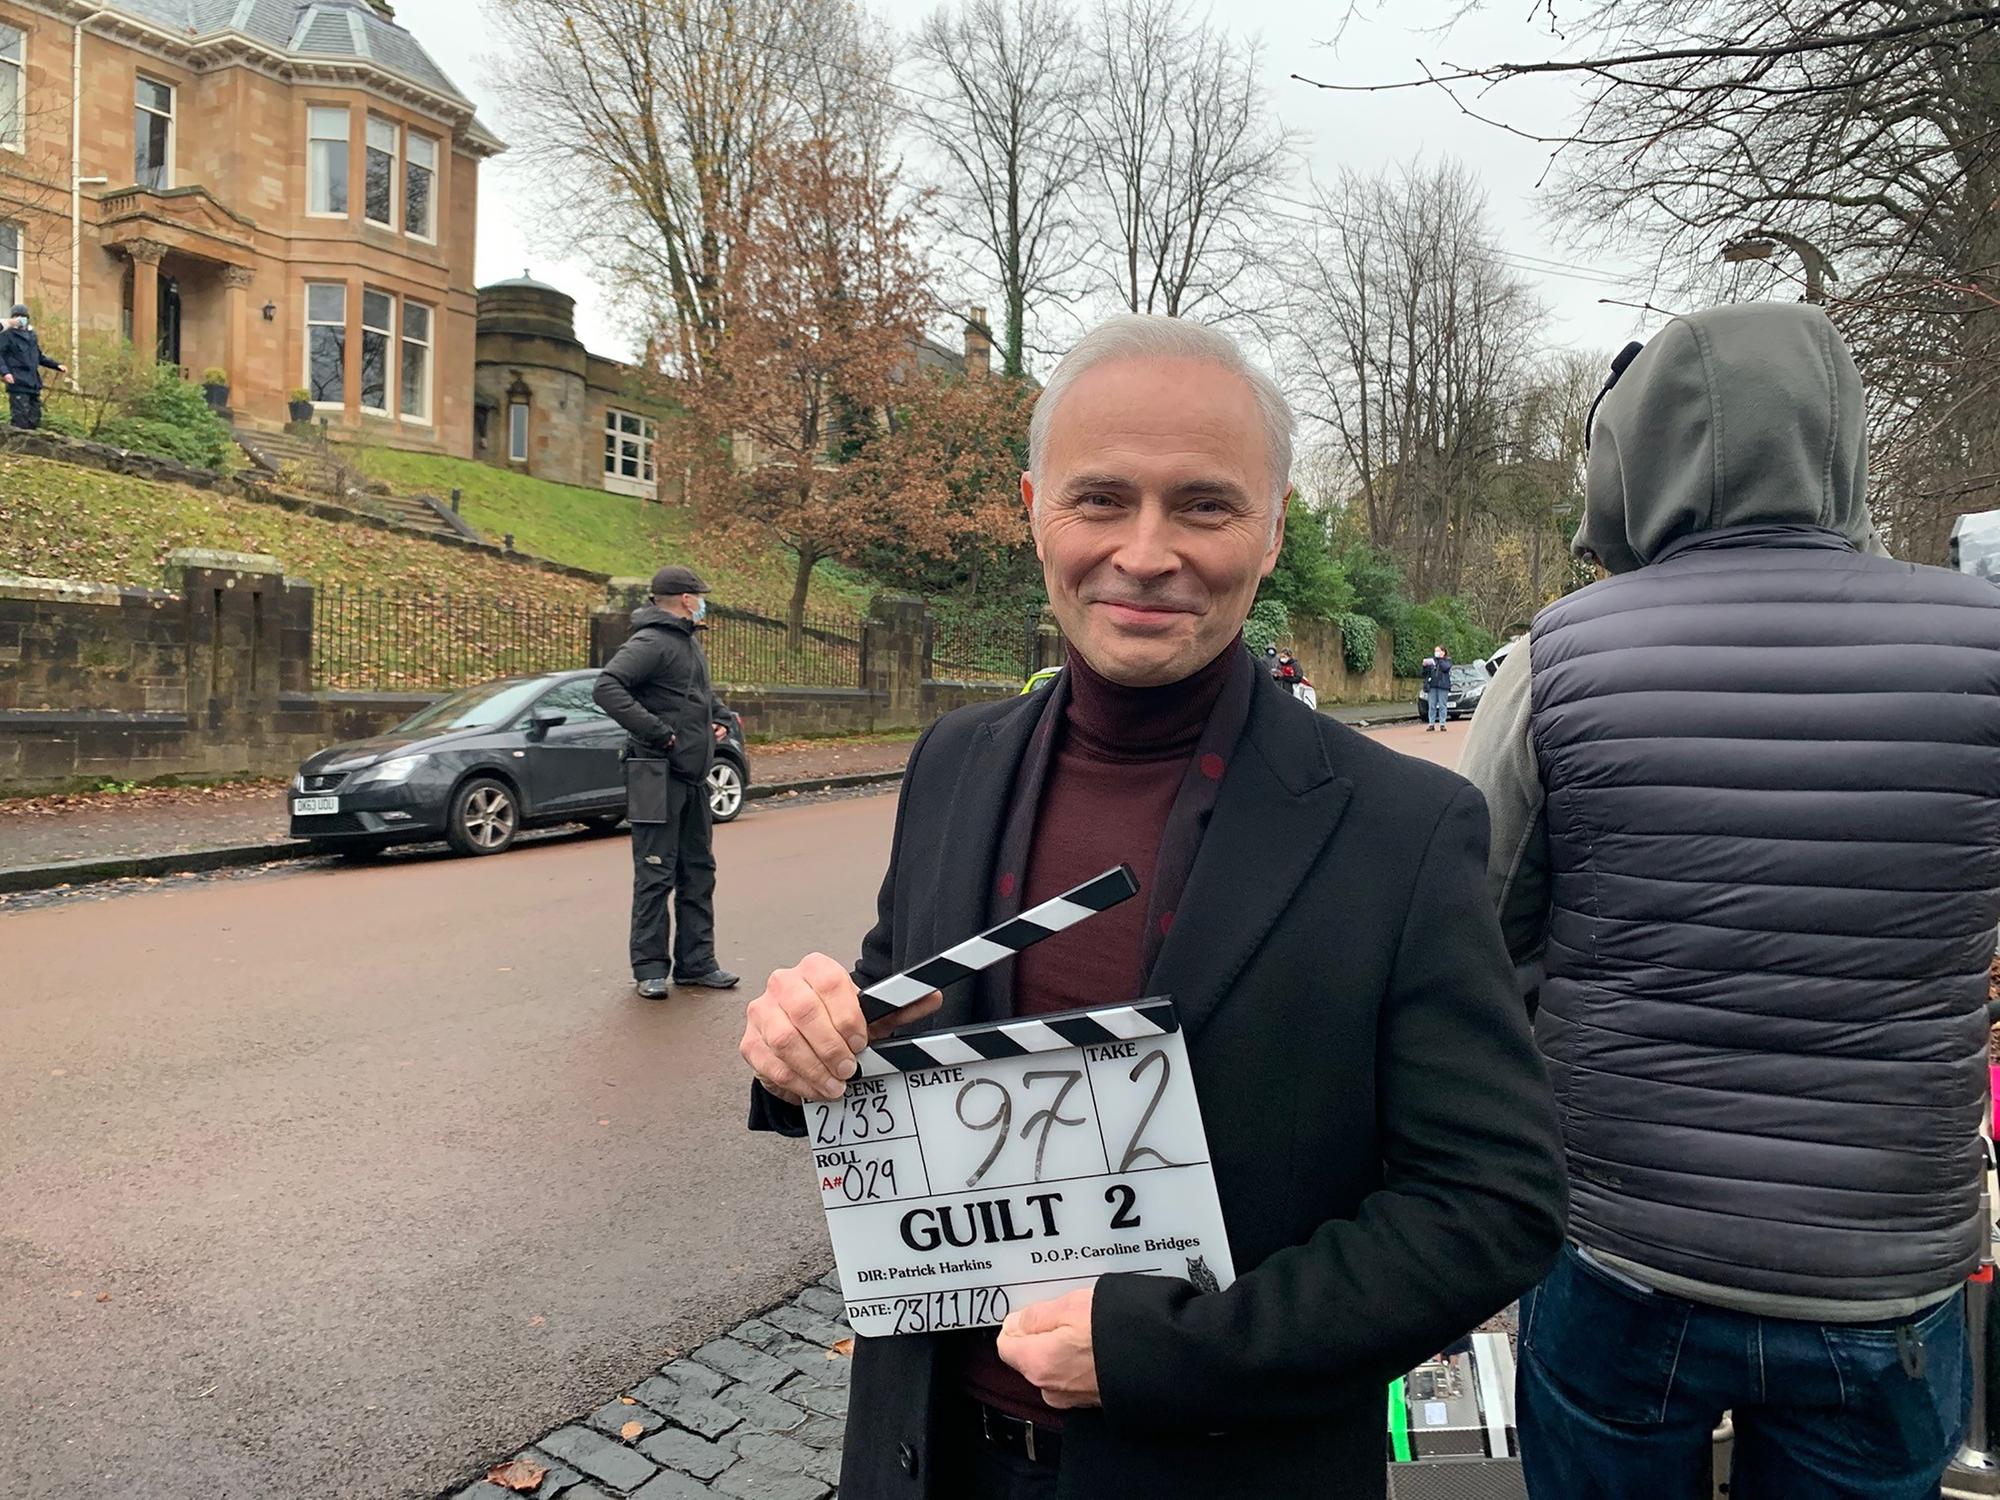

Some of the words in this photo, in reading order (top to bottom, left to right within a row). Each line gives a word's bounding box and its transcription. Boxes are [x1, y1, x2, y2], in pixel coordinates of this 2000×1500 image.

[1087, 1042, 1138, 1063] TAKE
[844, 1079, 887, 1098] CENE
[909, 1067, 965, 1089] SLATE
[816, 1094, 895, 1144] 2/33
[1119, 1050, 1190, 1174] 2
[955, 1070, 1086, 1187] 97
[816, 1150, 861, 1168] ROLL
[900, 1193, 1063, 1252] GUILT
[1104, 1184, 1141, 1229] 2
[1031, 1249, 1079, 1264] D.O.P:
[1081, 1243, 1141, 1259] Caroline
[1144, 1236, 1201, 1252] Bridges
[857, 1270, 888, 1283] DIR:
[889, 1263, 936, 1279] Patrick
[939, 1259, 993, 1274] Harkins
[849, 1303, 892, 1319] DATE:
